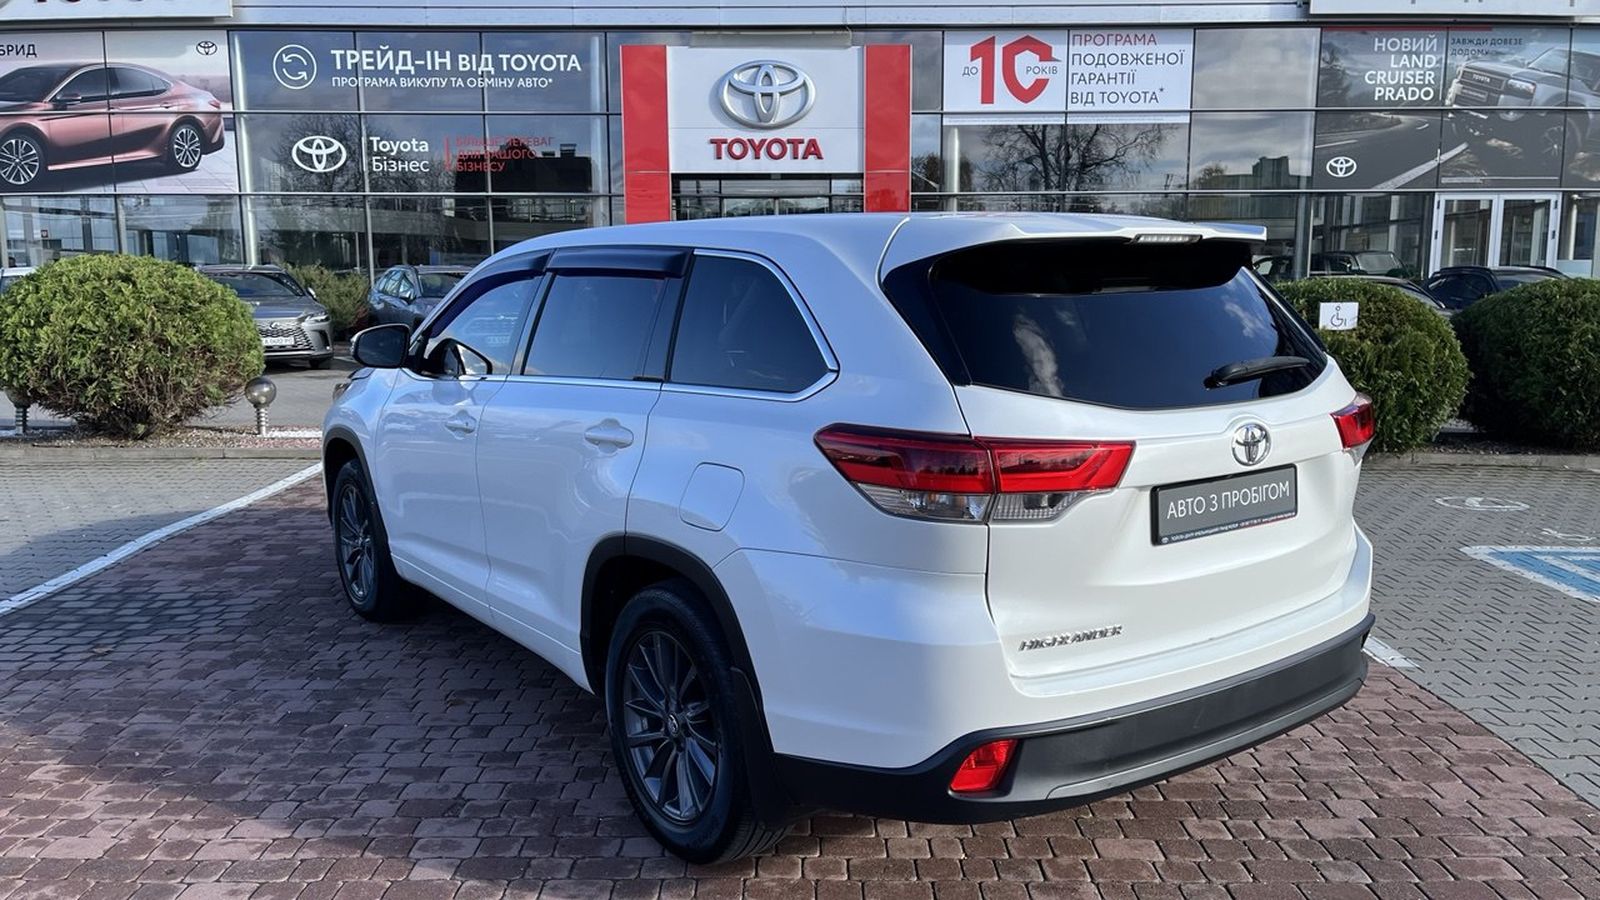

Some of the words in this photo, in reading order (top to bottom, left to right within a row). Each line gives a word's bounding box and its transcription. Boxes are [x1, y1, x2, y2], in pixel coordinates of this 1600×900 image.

[1072, 34, 1158, 46] ПРОГРАМА
[1374, 34, 1438, 52] НОВИЙ
[331, 46, 451, 75] ТРЕЙД-ІН
[458, 54, 495, 75] ВІД
[499, 54, 582, 72] TOYOTA
[1071, 49, 1186, 67] ПОДОВЖЕНОЇ
[1390, 55, 1437, 68] LAND
[962, 66, 979, 77] ДО
[1026, 65, 1058, 76] РОКІВ
[1071, 69, 1136, 86] ГАРАНТІЇ
[1365, 71, 1435, 85] CRUISER
[332, 76, 397, 88] ПРОГРАМА
[400, 76, 448, 89] ВИКУПУ
[450, 76, 465, 88] ТА
[466, 77, 515, 88] ОБМІНУ
[1070, 92, 1096, 106] ВІД
[1374, 87, 1434, 101] PRADO
[369, 136, 429, 154] Toyota
[710, 138, 824, 160] TOYOTA
[372, 156, 430, 172] Бізнес
[1166, 496, 1206, 519] АВТО
[1221, 480, 1290, 510] ПРОБІГОМ
[1018, 625, 1123, 652] HIGHLANDER
